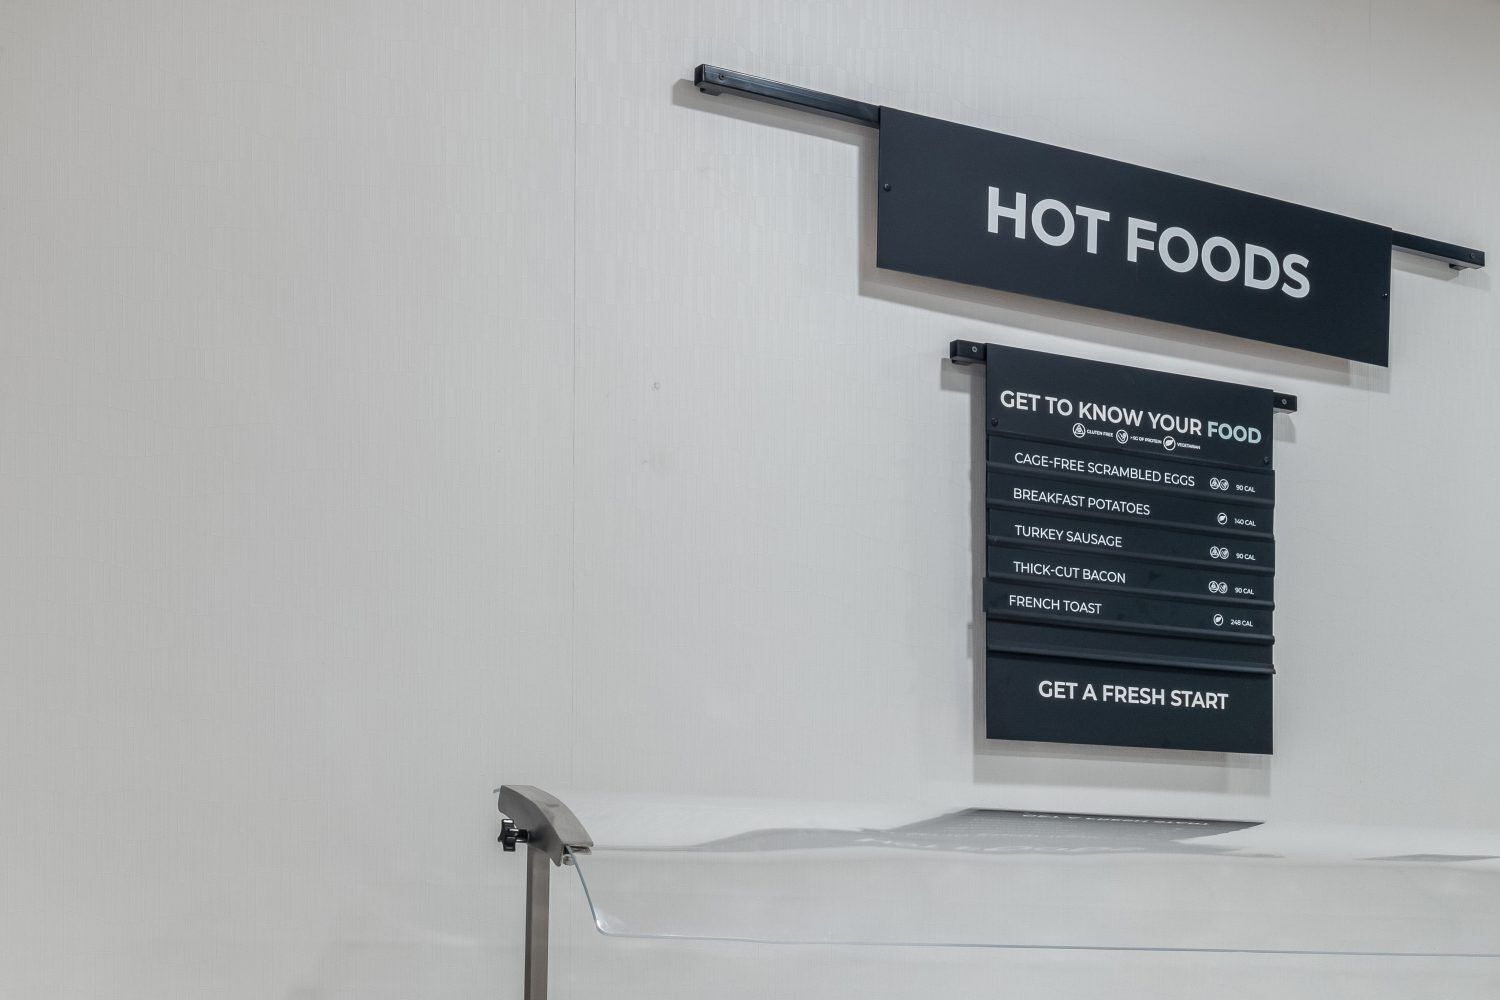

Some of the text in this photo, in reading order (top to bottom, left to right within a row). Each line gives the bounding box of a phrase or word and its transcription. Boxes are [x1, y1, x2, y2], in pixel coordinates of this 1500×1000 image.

[987, 186, 1311, 298] HOT FOODS
[1000, 390, 1262, 444] GET TO KNOW YOUR FOOD
[1014, 452, 1195, 488] CAGE-FREE SCRAMBLED EGGS
[1013, 488, 1150, 516] BREAKFAST POTATOES
[1015, 524, 1122, 548] TURKEY SAUSAGE
[1014, 561, 1126, 584] THICK-CUT BACON
[1009, 595, 1102, 614] FRENCH TOAST
[1038, 680, 1229, 710] GET A FRESH START
